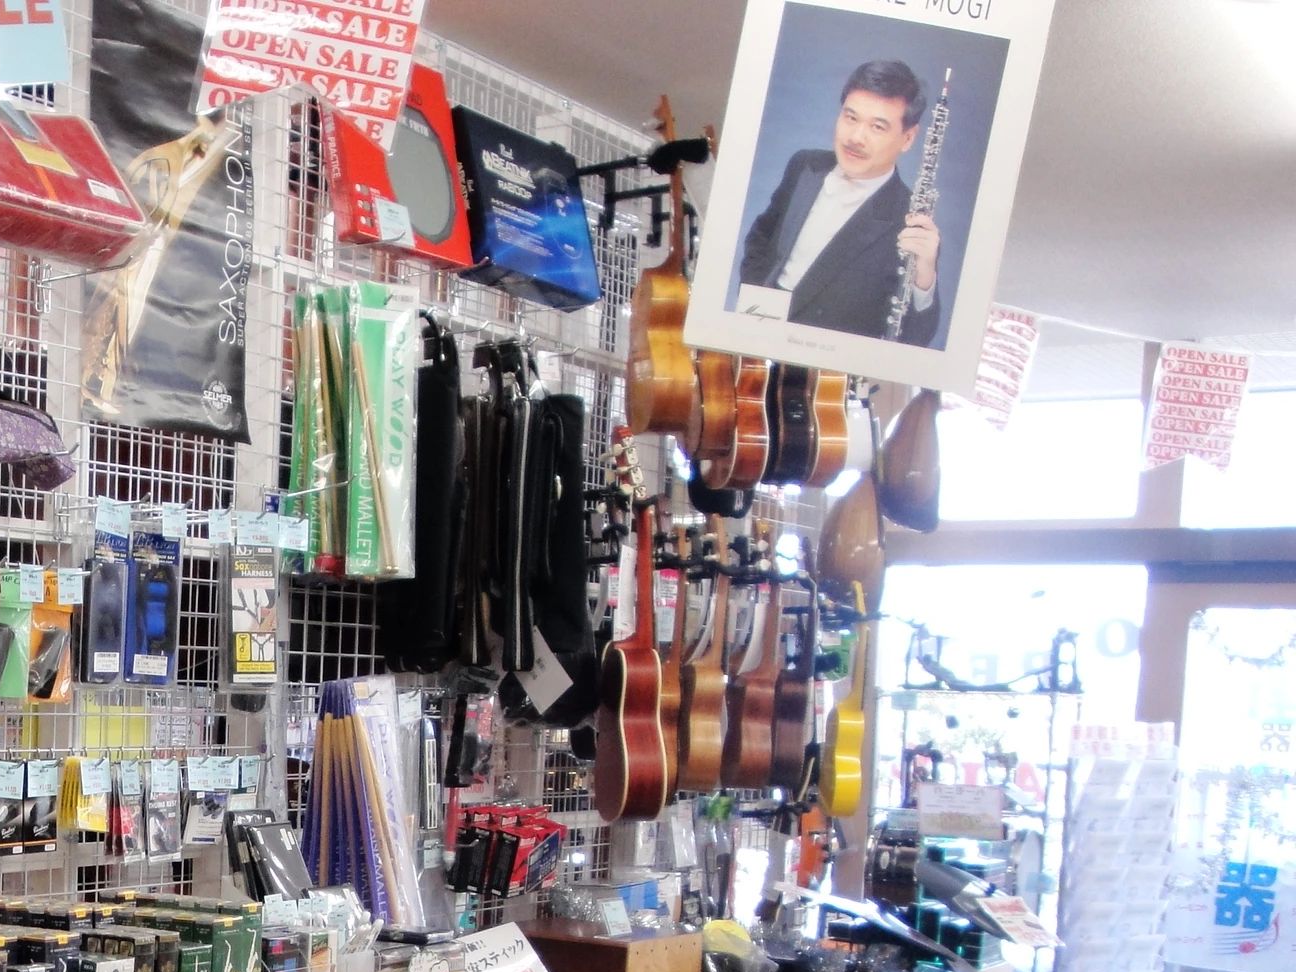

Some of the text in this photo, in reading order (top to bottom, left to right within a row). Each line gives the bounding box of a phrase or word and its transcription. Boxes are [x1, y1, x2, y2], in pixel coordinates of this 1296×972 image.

[326, 11, 409, 48] SALE
[222, 28, 399, 81] OPEN SALE
[311, 74, 394, 111] SALE
[246, 178, 255, 217] SERIE
[219, 104, 245, 345] SAXOPHONE
[239, 244, 253, 293] ACTION
[237, 313, 247, 347] SUPER
[1165, 360, 1246, 379] OPEN SALE
[1166, 347, 1248, 366] OPEN SALE
[1159, 388, 1240, 407] OPEN SALE
[1162, 375, 1242, 394] OPEN SALE
[1156, 417, 1196, 432] OPEN
[241, 569, 274, 577] HARNESS
